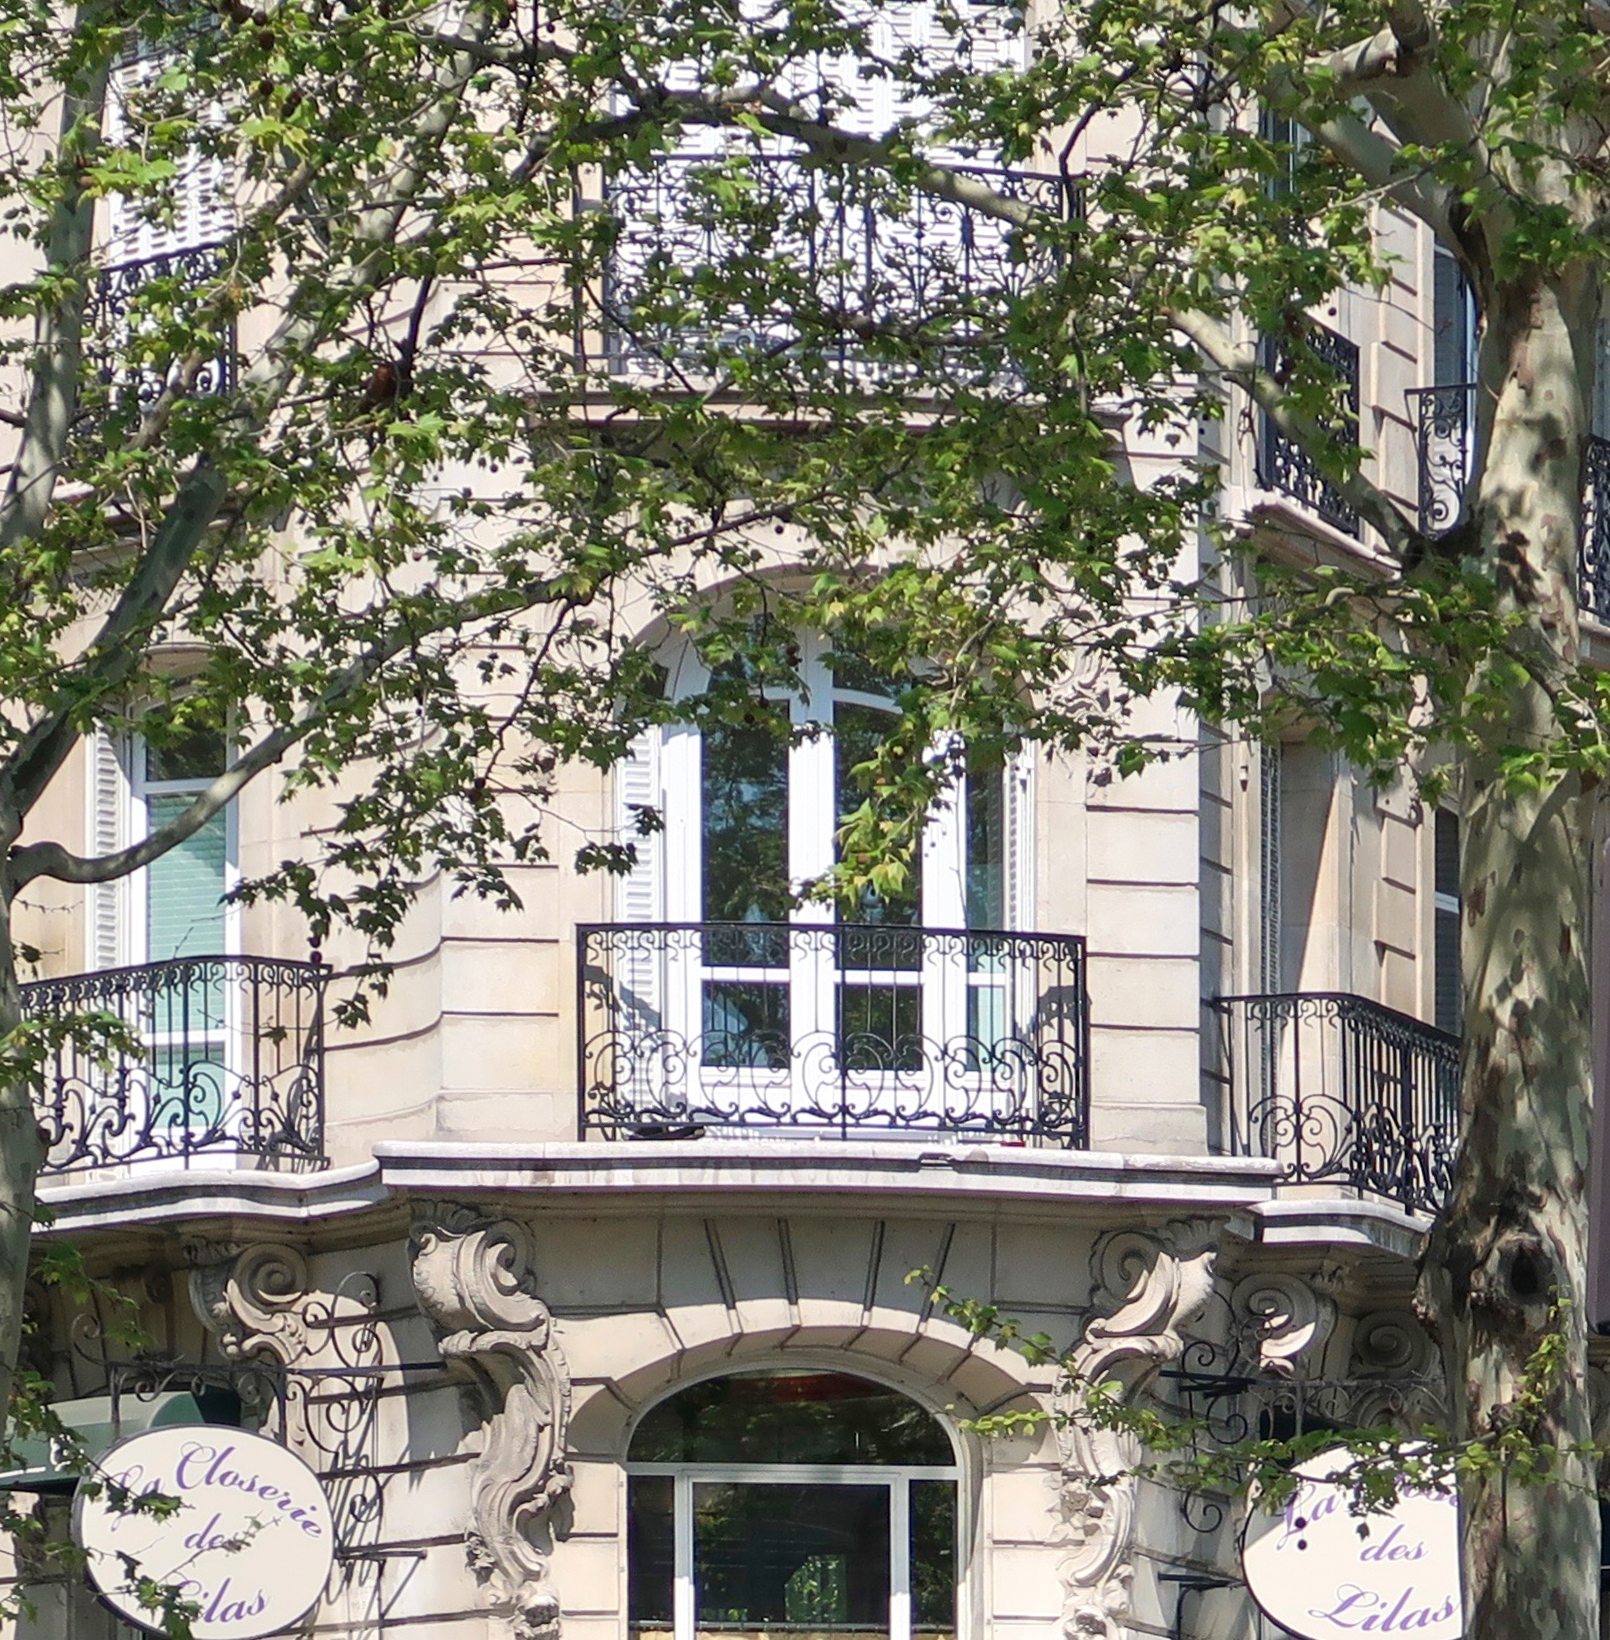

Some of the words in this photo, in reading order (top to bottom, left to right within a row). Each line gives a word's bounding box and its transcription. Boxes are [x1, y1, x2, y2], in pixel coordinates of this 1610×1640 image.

[175, 1441, 323, 1539] Closerie
[1275, 1483, 1341, 1551] La
[1359, 1524, 1428, 1562] des
[1307, 1583, 1462, 1633] Lilas
